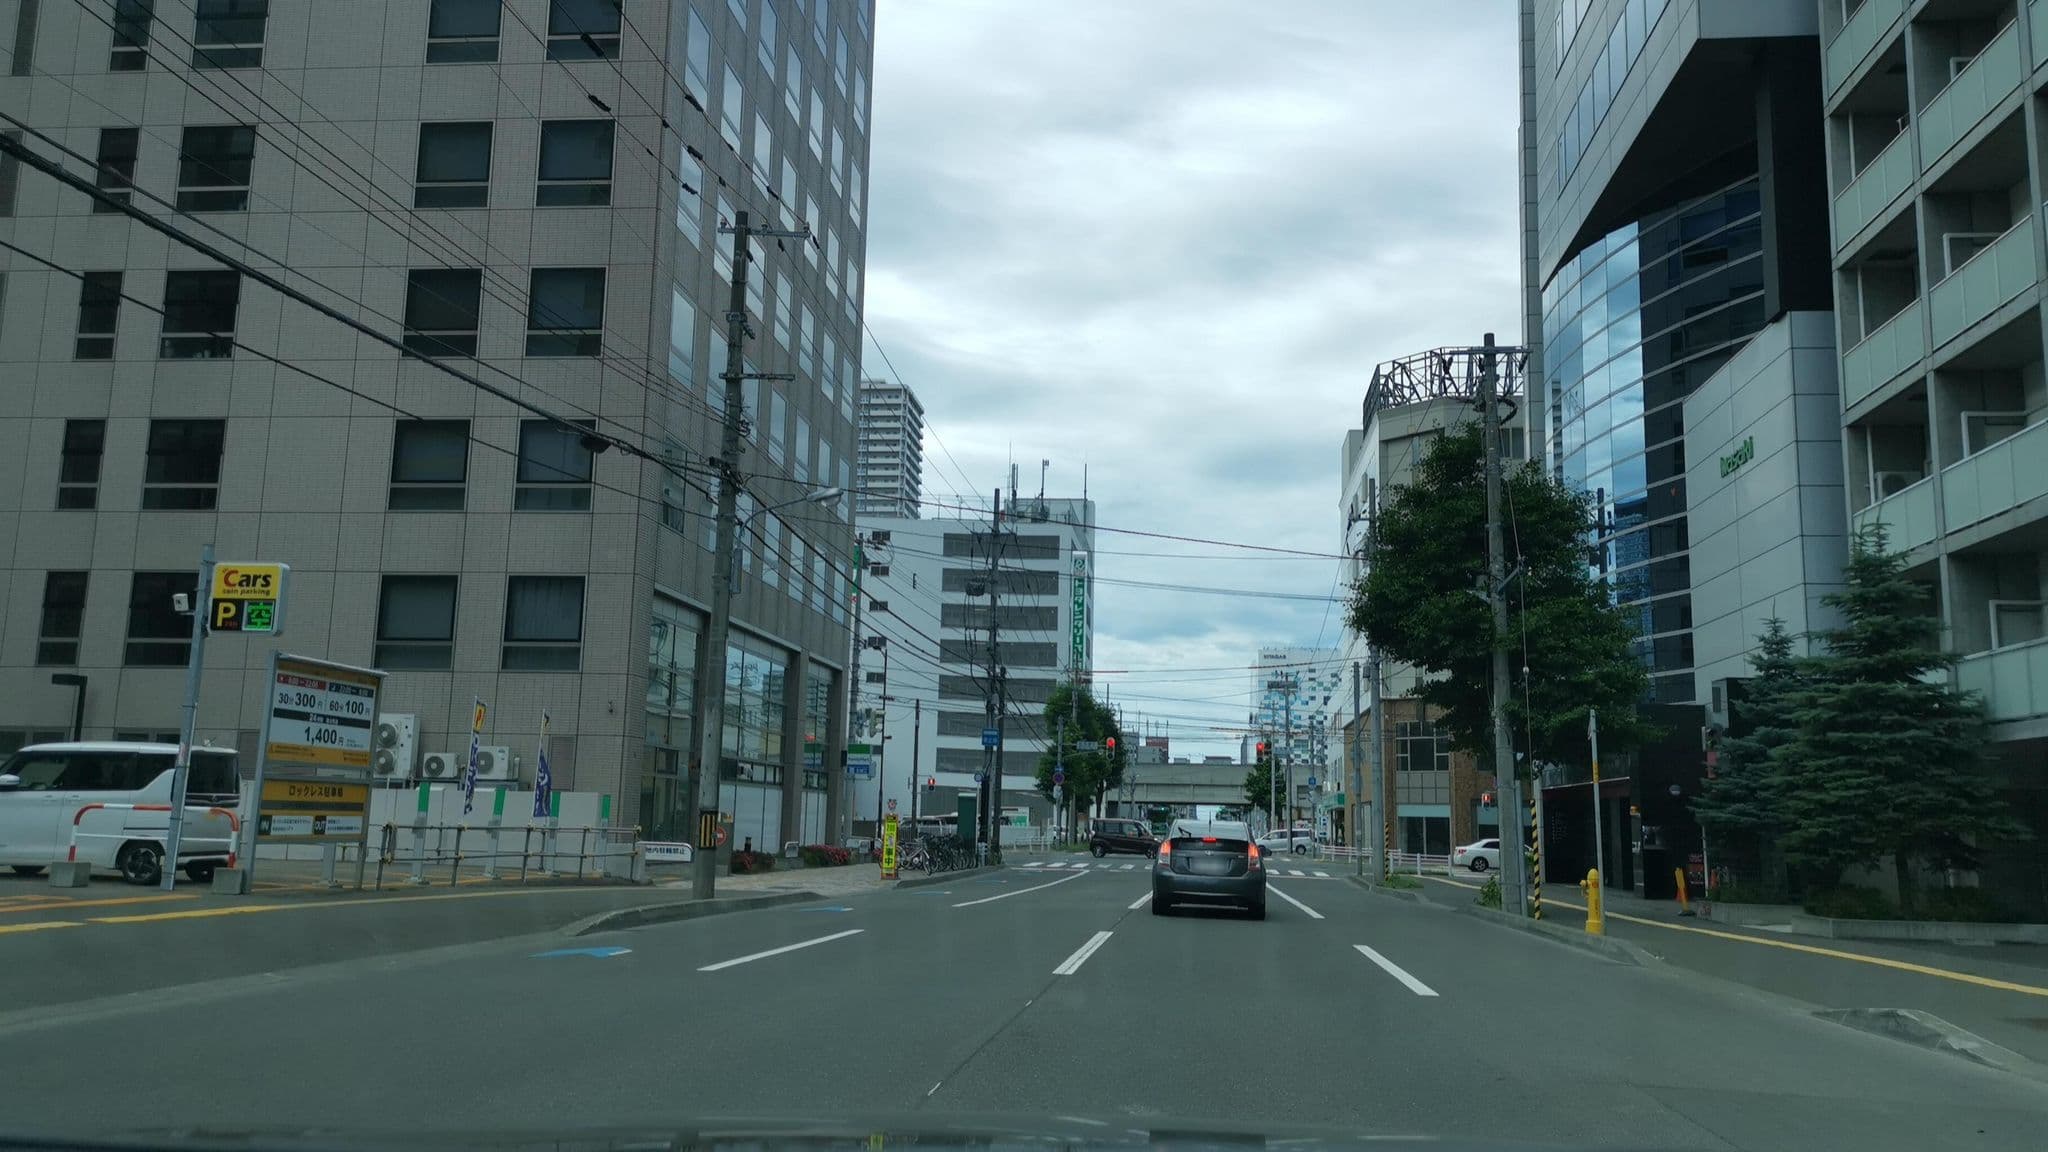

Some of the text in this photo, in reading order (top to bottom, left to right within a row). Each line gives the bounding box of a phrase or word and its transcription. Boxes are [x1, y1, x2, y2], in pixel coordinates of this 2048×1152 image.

[223, 569, 272, 588] Cars
[240, 588, 270, 597] parking
[217, 602, 236, 627] P
[247, 601, 273, 629] 空
